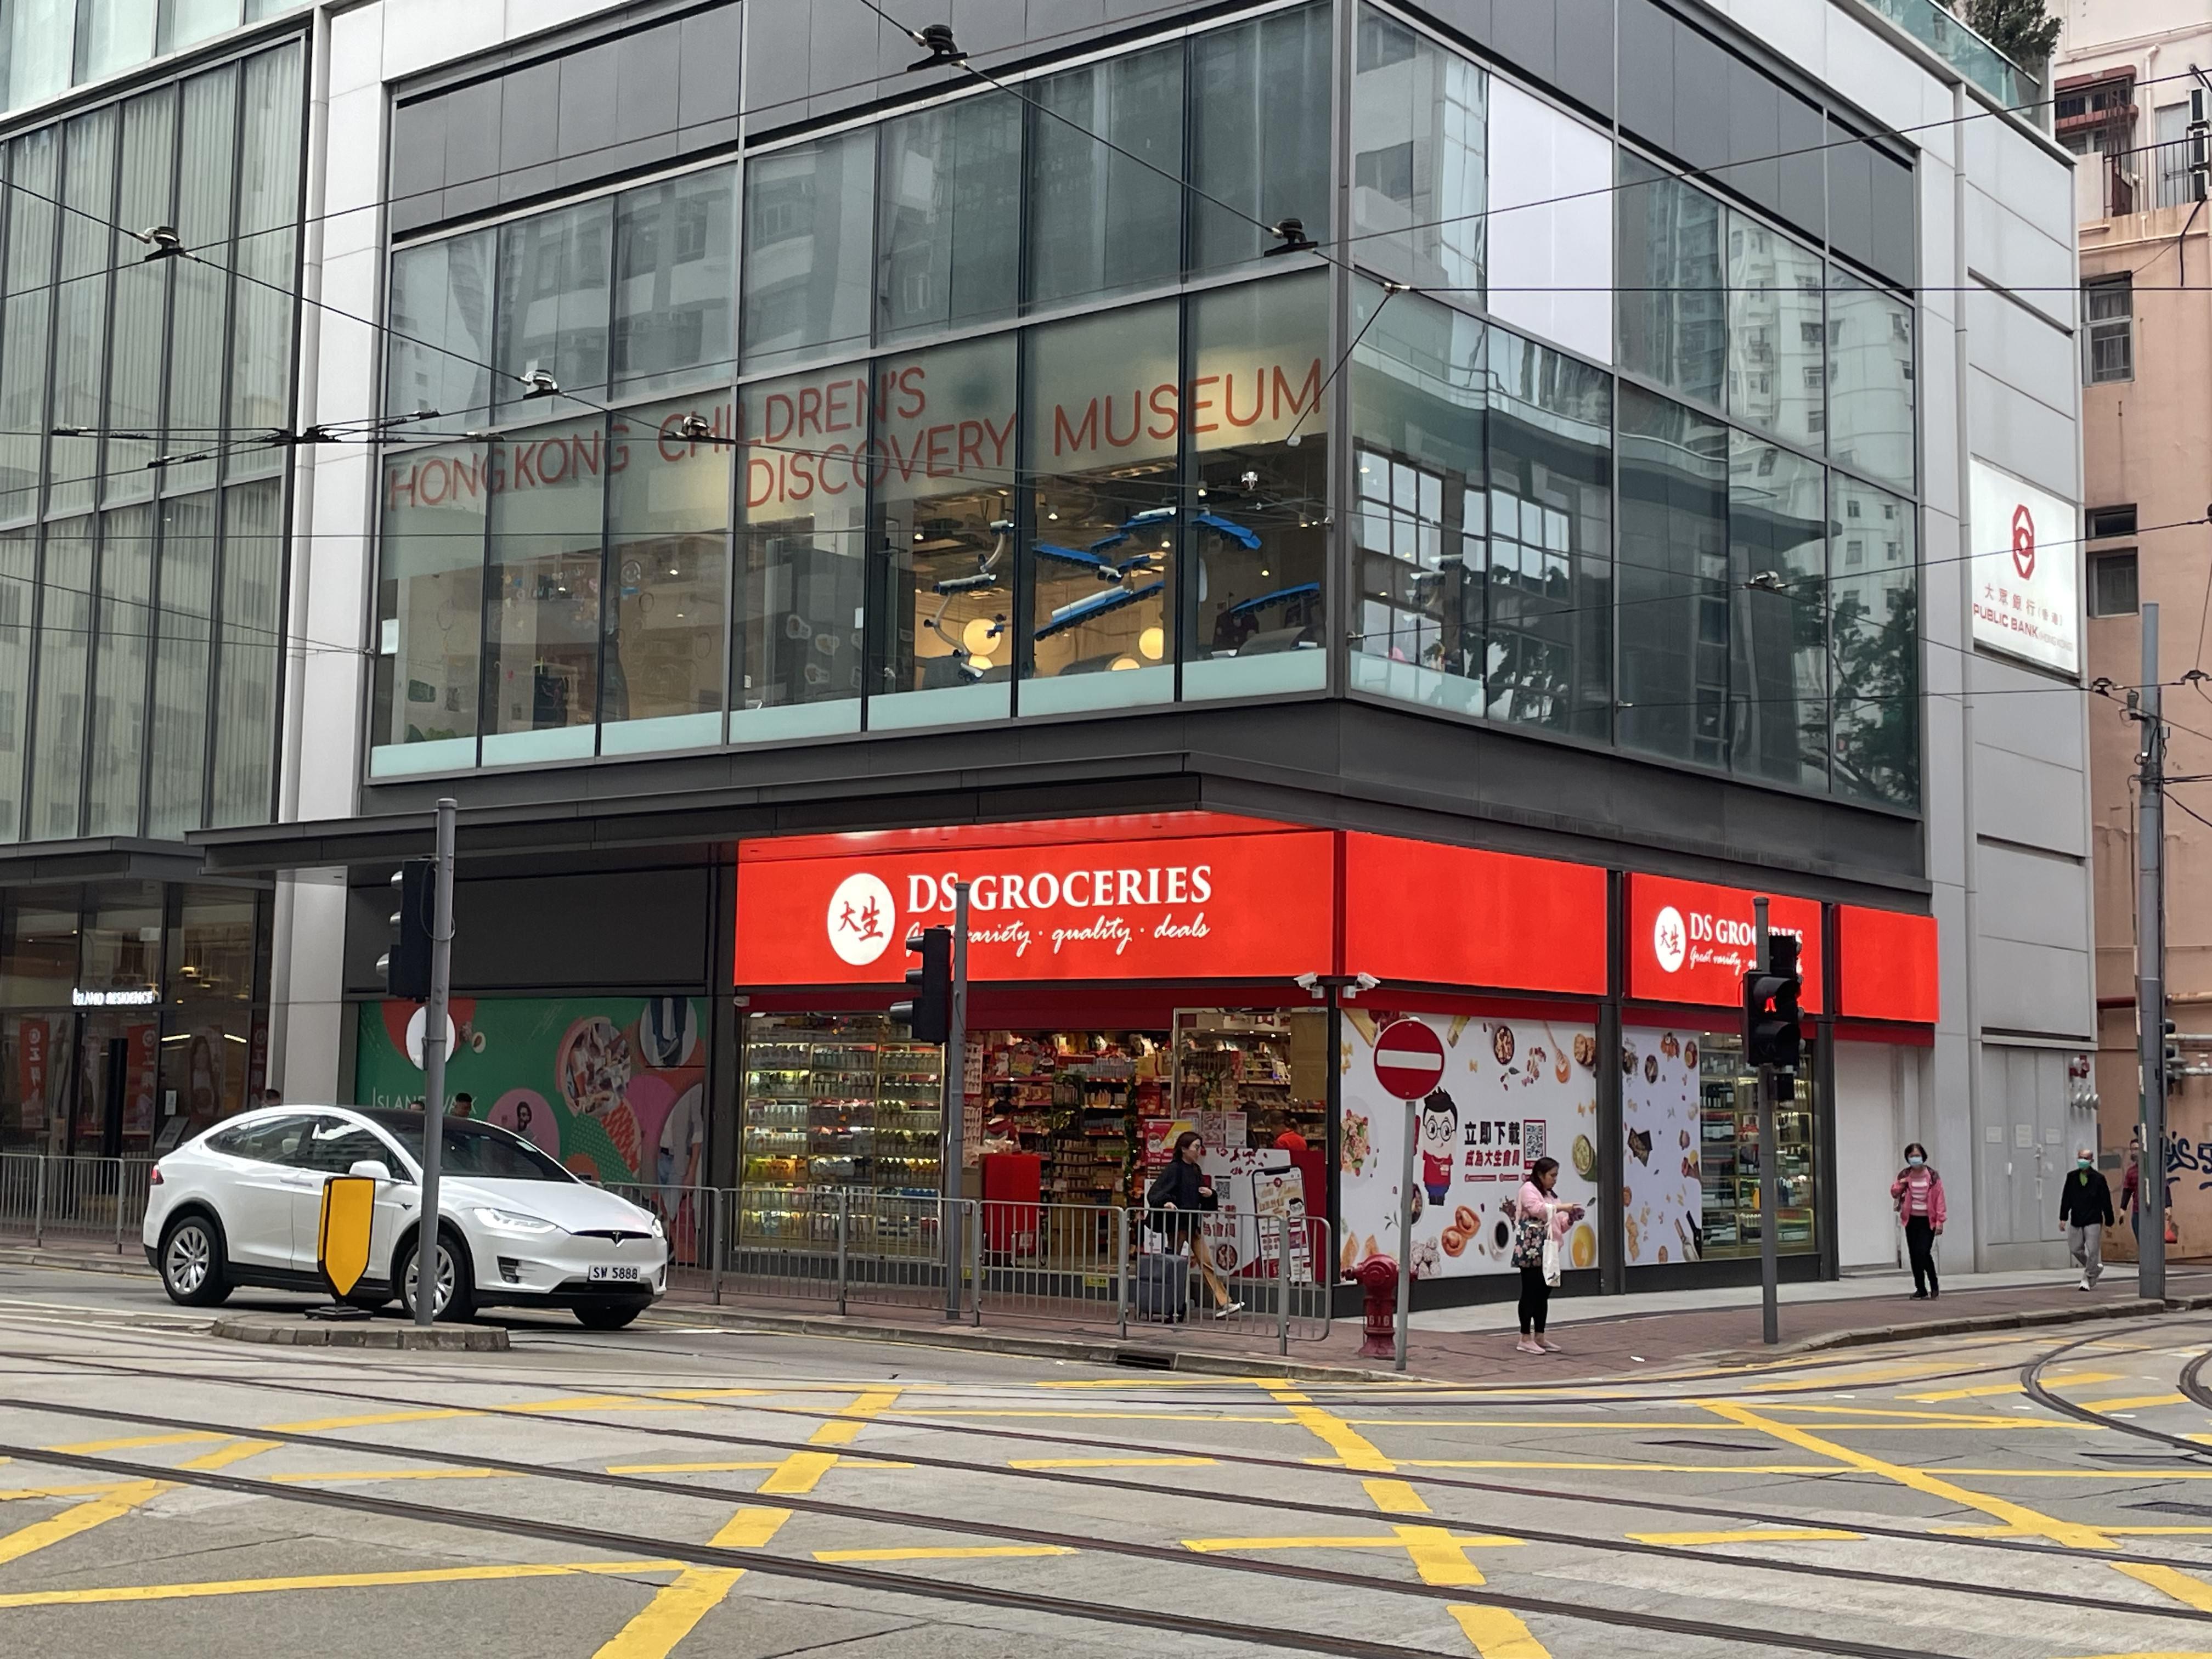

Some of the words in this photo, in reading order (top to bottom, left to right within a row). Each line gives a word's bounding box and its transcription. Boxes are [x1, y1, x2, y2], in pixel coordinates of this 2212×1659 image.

[658, 366, 926, 461] CHILDREN'S
[746, 413, 1015, 508] DISCOVERY
[1056, 358, 1322, 456] MUSEUM
[1973, 603, 2008, 628] PUBLIC
[2011, 617, 2039, 639] BANK
[906, 872, 959, 913] DS
[969, 865, 1212, 911] GROCERIES
[838, 895, 884, 944] 大生
[967, 919, 1031, 957] ariety
[1051, 915, 1132, 955] quality
[1154, 912, 1211, 939] deals
[1690, 912, 1713, 942] DS
[1660, 923, 1681, 955] 大生
[373, 1087, 426, 1110] ISLAN
[1464, 1121, 1520, 1146] 立即下載
[612, 1267, 638, 1279] 5888
